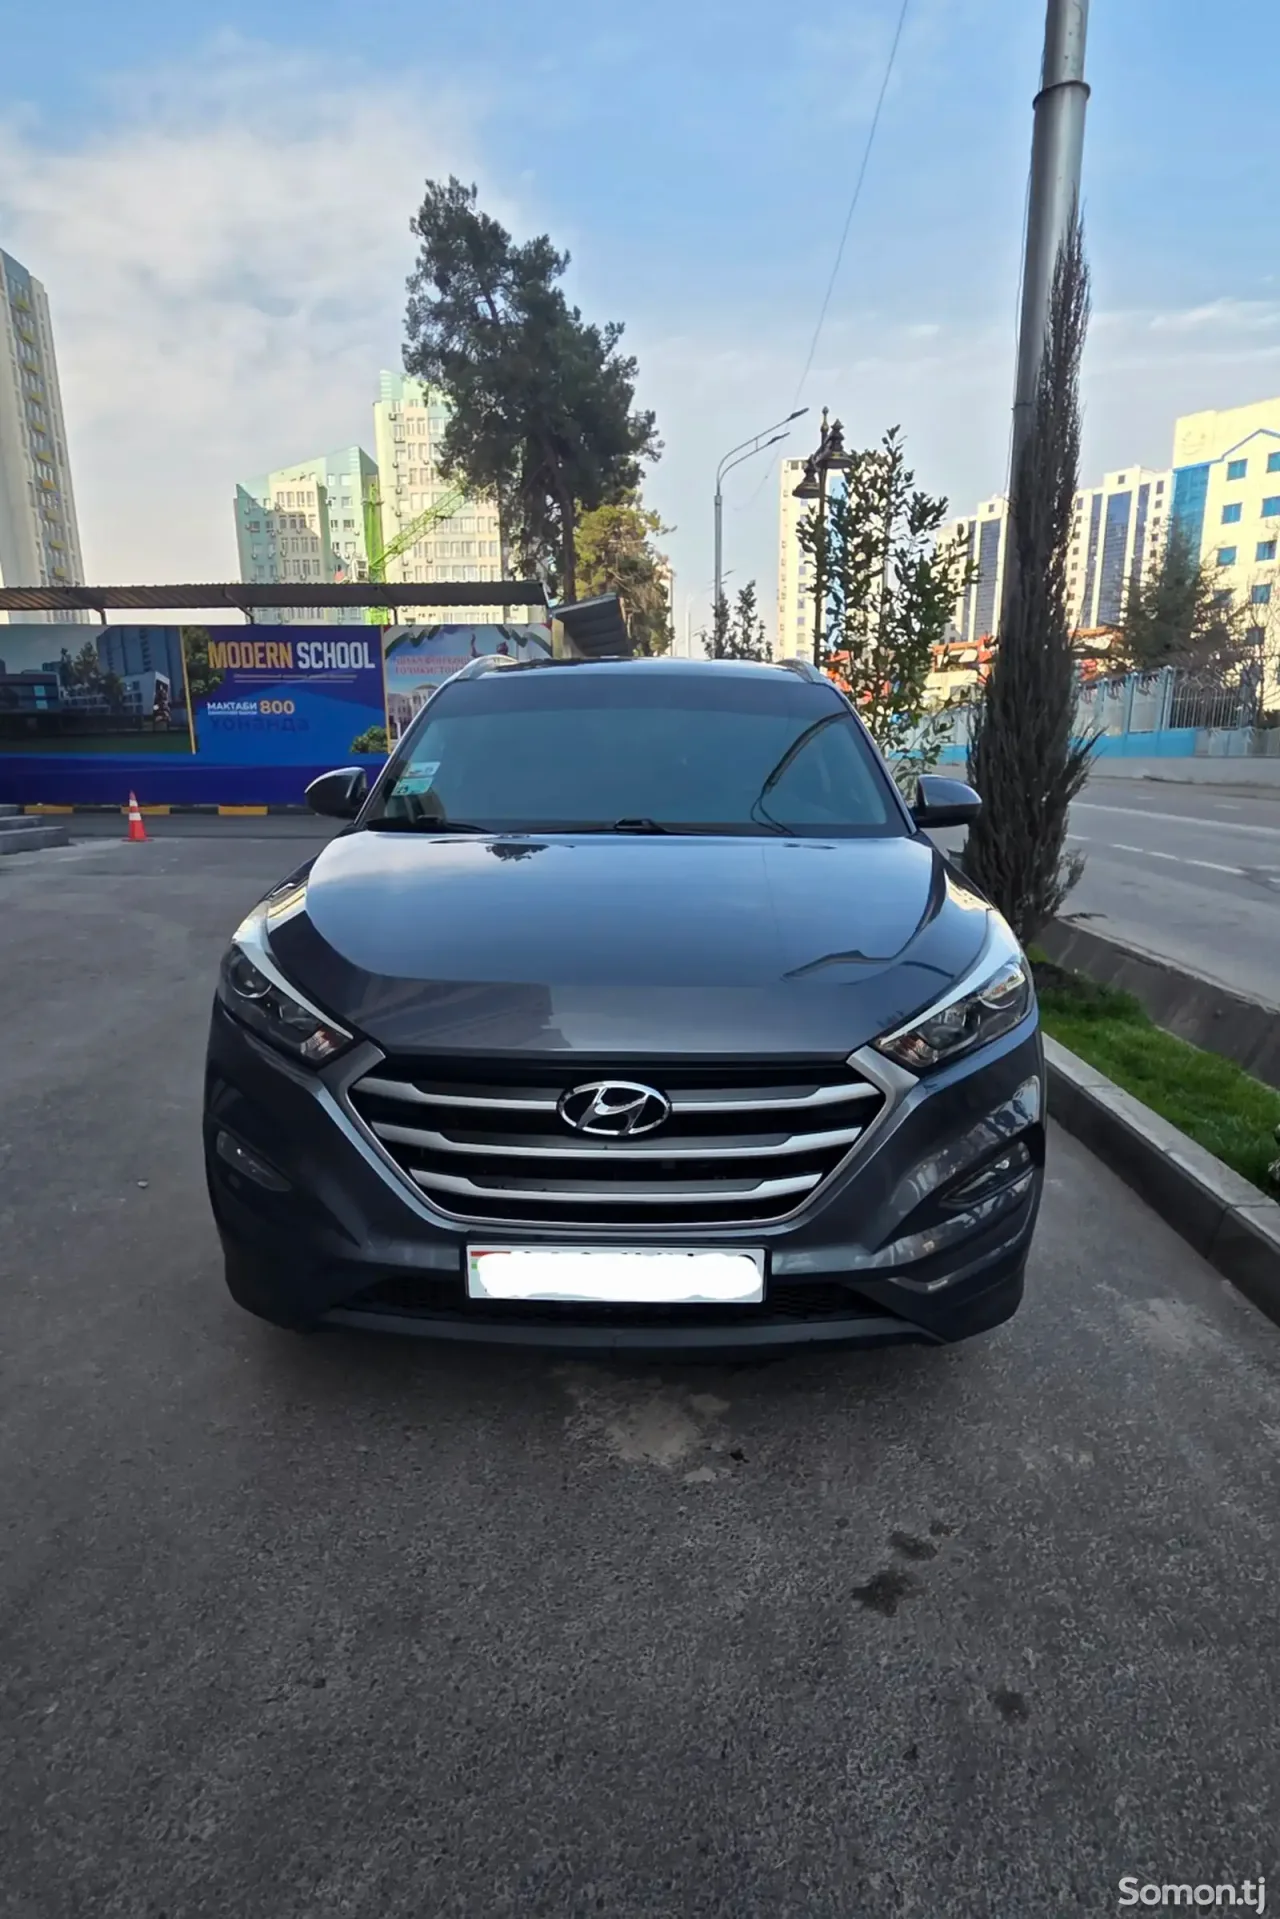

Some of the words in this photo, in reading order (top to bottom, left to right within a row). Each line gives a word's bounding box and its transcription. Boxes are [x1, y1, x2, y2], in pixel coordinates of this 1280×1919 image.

[207, 641, 294, 669] MODERN
[296, 641, 376, 669] SCHOOL
[207, 702, 258, 711] МАКТАБИ
[260, 700, 295, 715] 800
